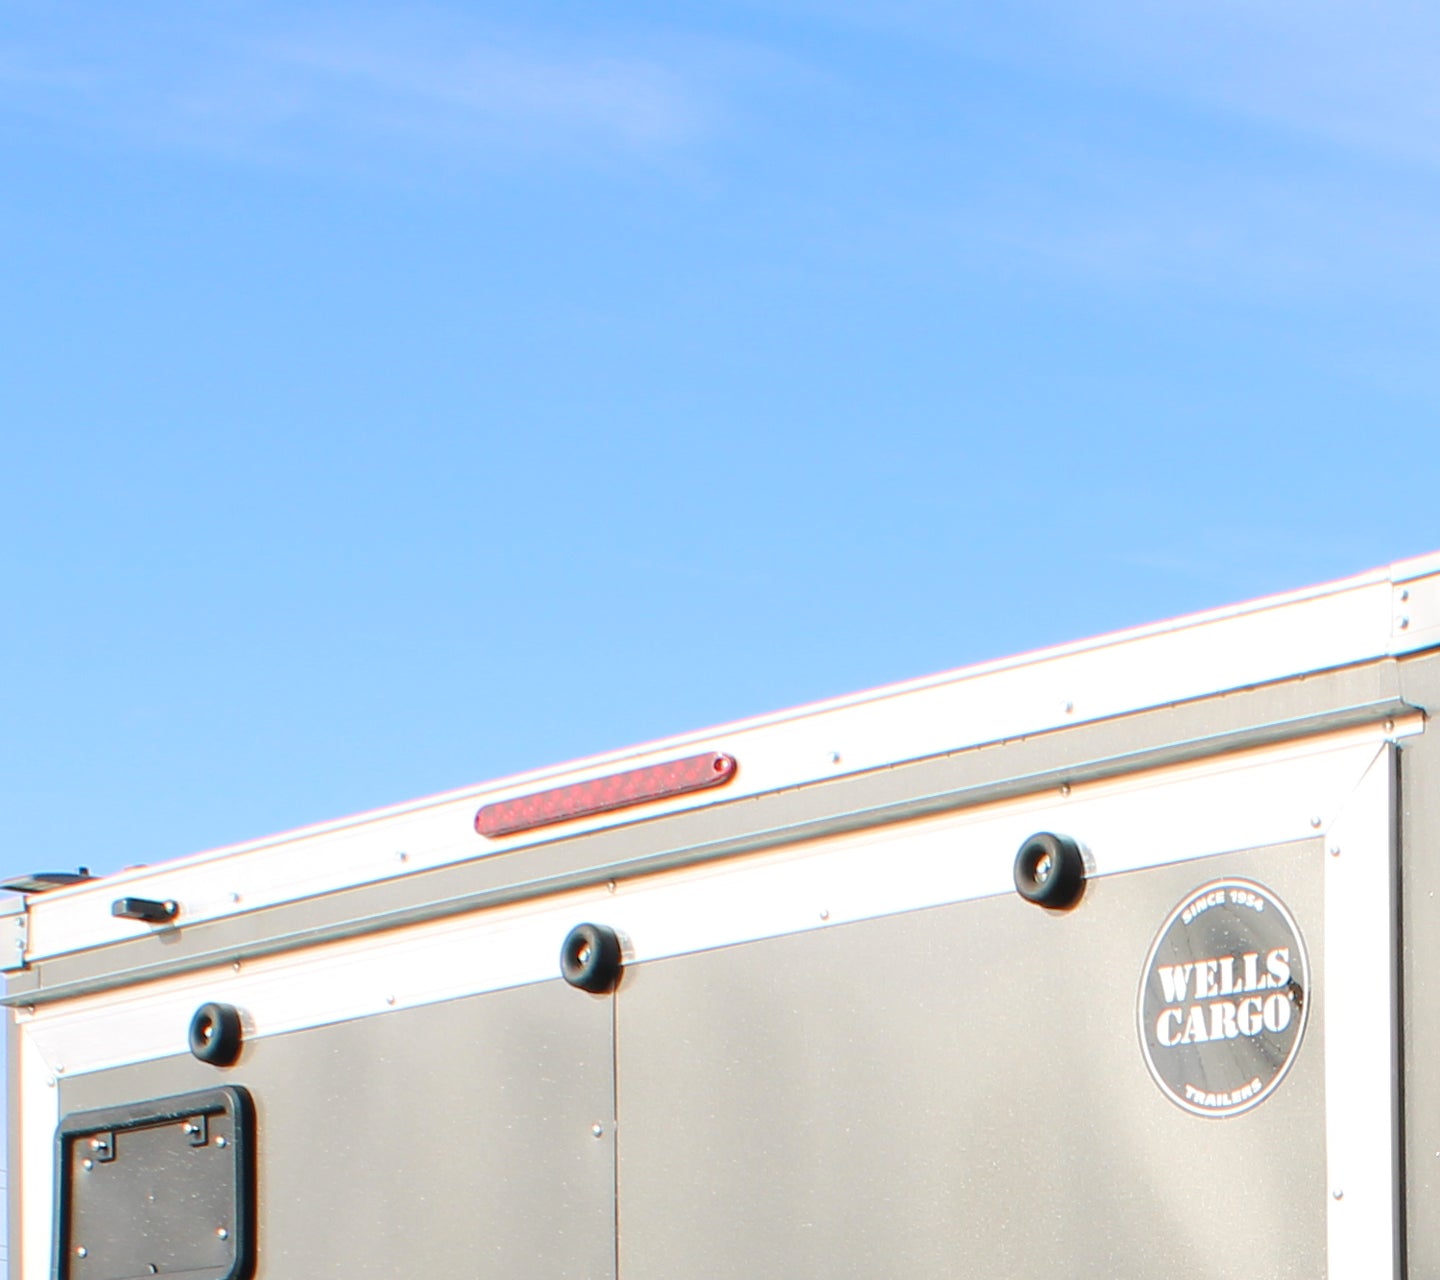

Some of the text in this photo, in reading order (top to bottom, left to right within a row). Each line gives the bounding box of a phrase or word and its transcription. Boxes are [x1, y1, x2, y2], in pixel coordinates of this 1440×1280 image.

[1180, 888, 1265, 925] SINCE 1954
[1157, 947, 1291, 1003] WELLS
[1155, 993, 1292, 1048] CARGO
[1185, 1077, 1262, 1107] TRAILERS
